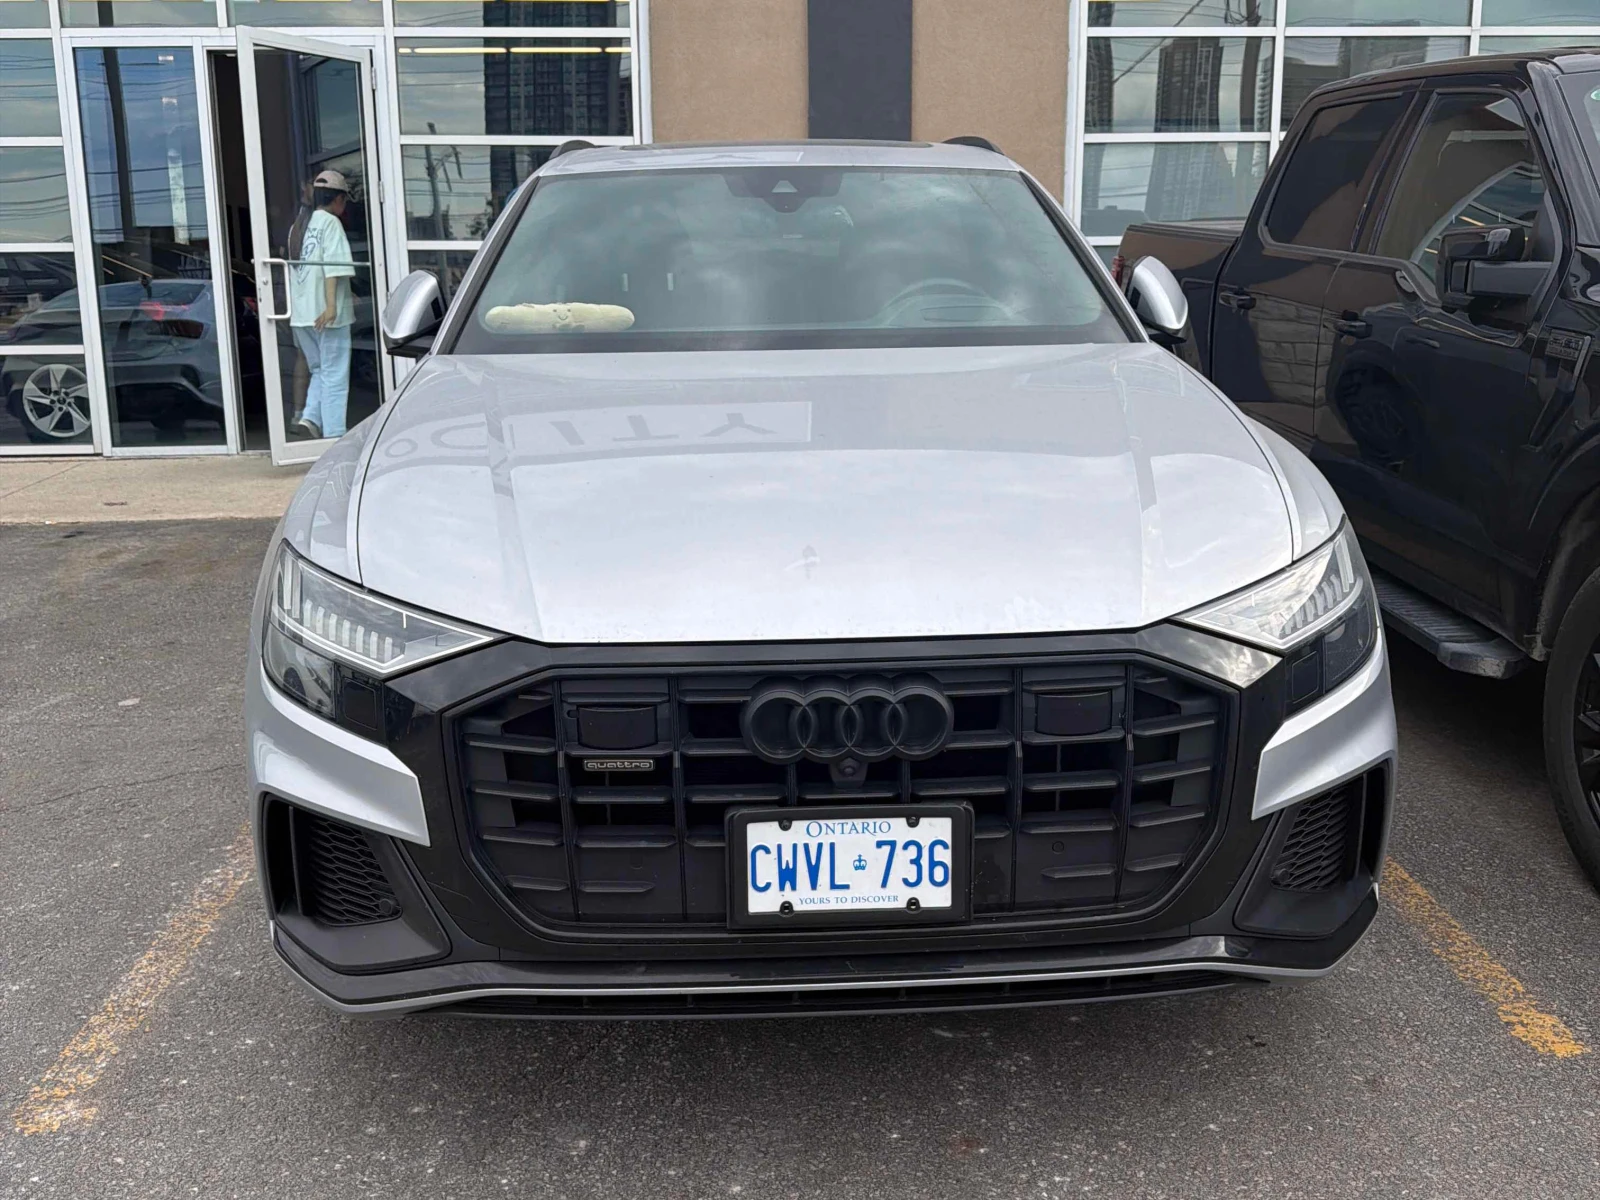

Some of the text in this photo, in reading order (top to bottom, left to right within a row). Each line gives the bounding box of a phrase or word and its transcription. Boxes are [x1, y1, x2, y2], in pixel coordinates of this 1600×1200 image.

[587, 761, 650, 769] quattro
[806, 821, 891, 837] ONTARIO
[750, 839, 950, 893] CWVL 736
[799, 895, 899, 905] YOURS TO DISCOVER
